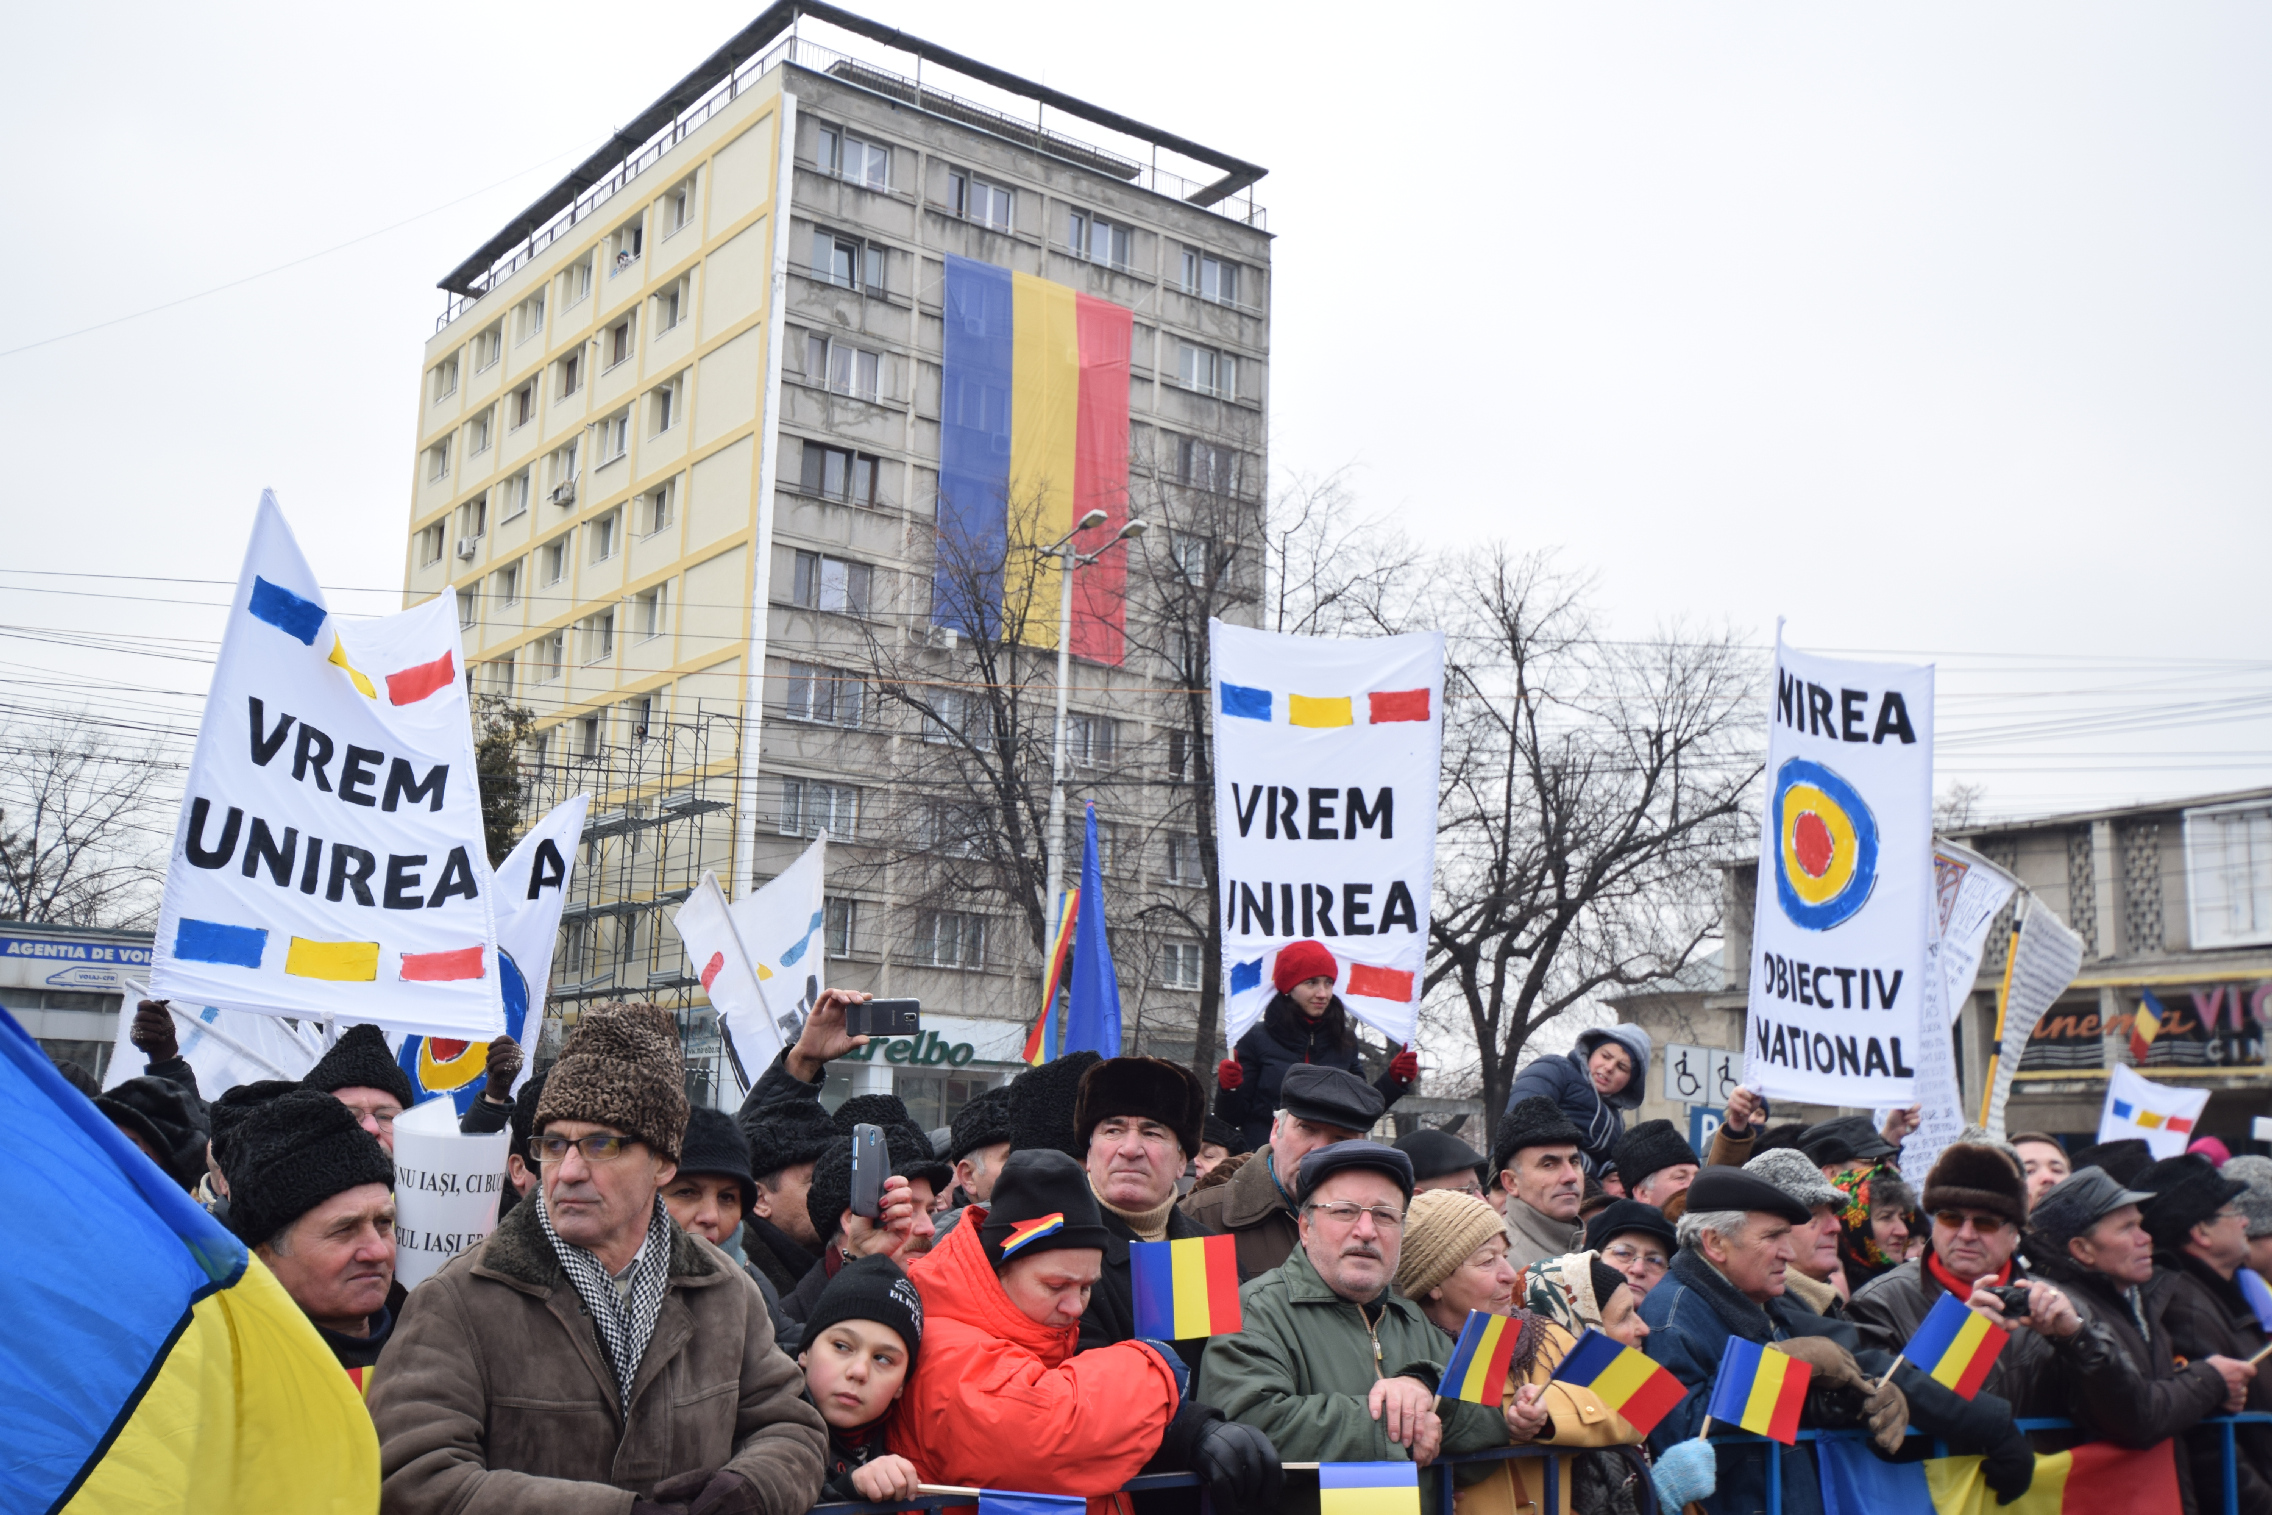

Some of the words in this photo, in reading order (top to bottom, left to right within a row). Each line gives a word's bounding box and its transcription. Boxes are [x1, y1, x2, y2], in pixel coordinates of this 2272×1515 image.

[248, 695, 450, 813] VREM
[1232, 782, 1394, 840] VREM
[185, 796, 479, 910] UNIREA
[7, 942, 86, 959] AGENTIA
[91, 947, 114, 960] DE
[119, 949, 152, 963] VOI
[1764, 951, 1904, 1010] OBIECTIV
[1756, 1016, 1914, 1078] NATIONAL
[398, 1166, 416, 1189] NU
[466, 1174, 484, 1193] CI
